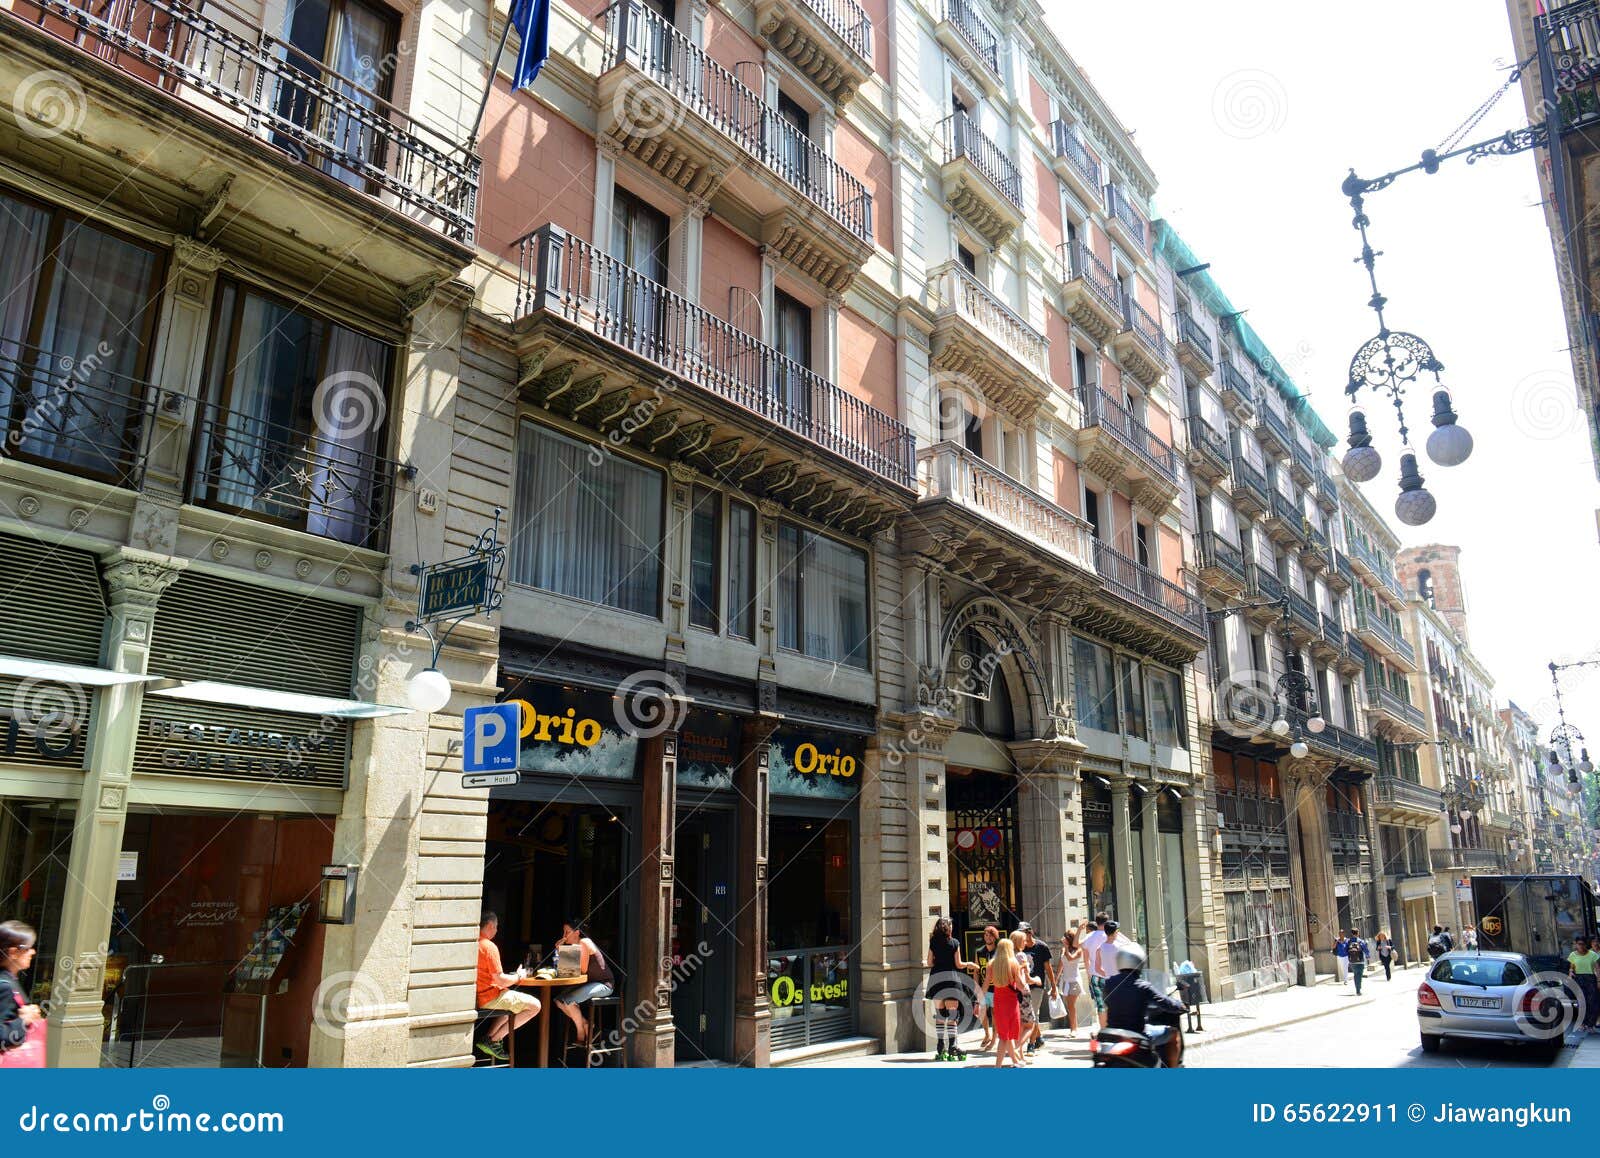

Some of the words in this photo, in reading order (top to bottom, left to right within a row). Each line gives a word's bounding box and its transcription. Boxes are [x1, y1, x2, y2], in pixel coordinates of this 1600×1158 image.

[424, 494, 436, 507] 40
[503, 698, 602, 747] Orio
[473, 712, 506, 766] P
[794, 742, 856, 777] Orio
[715, 885, 726, 895] RB
[1484, 920, 1501, 934] ups
